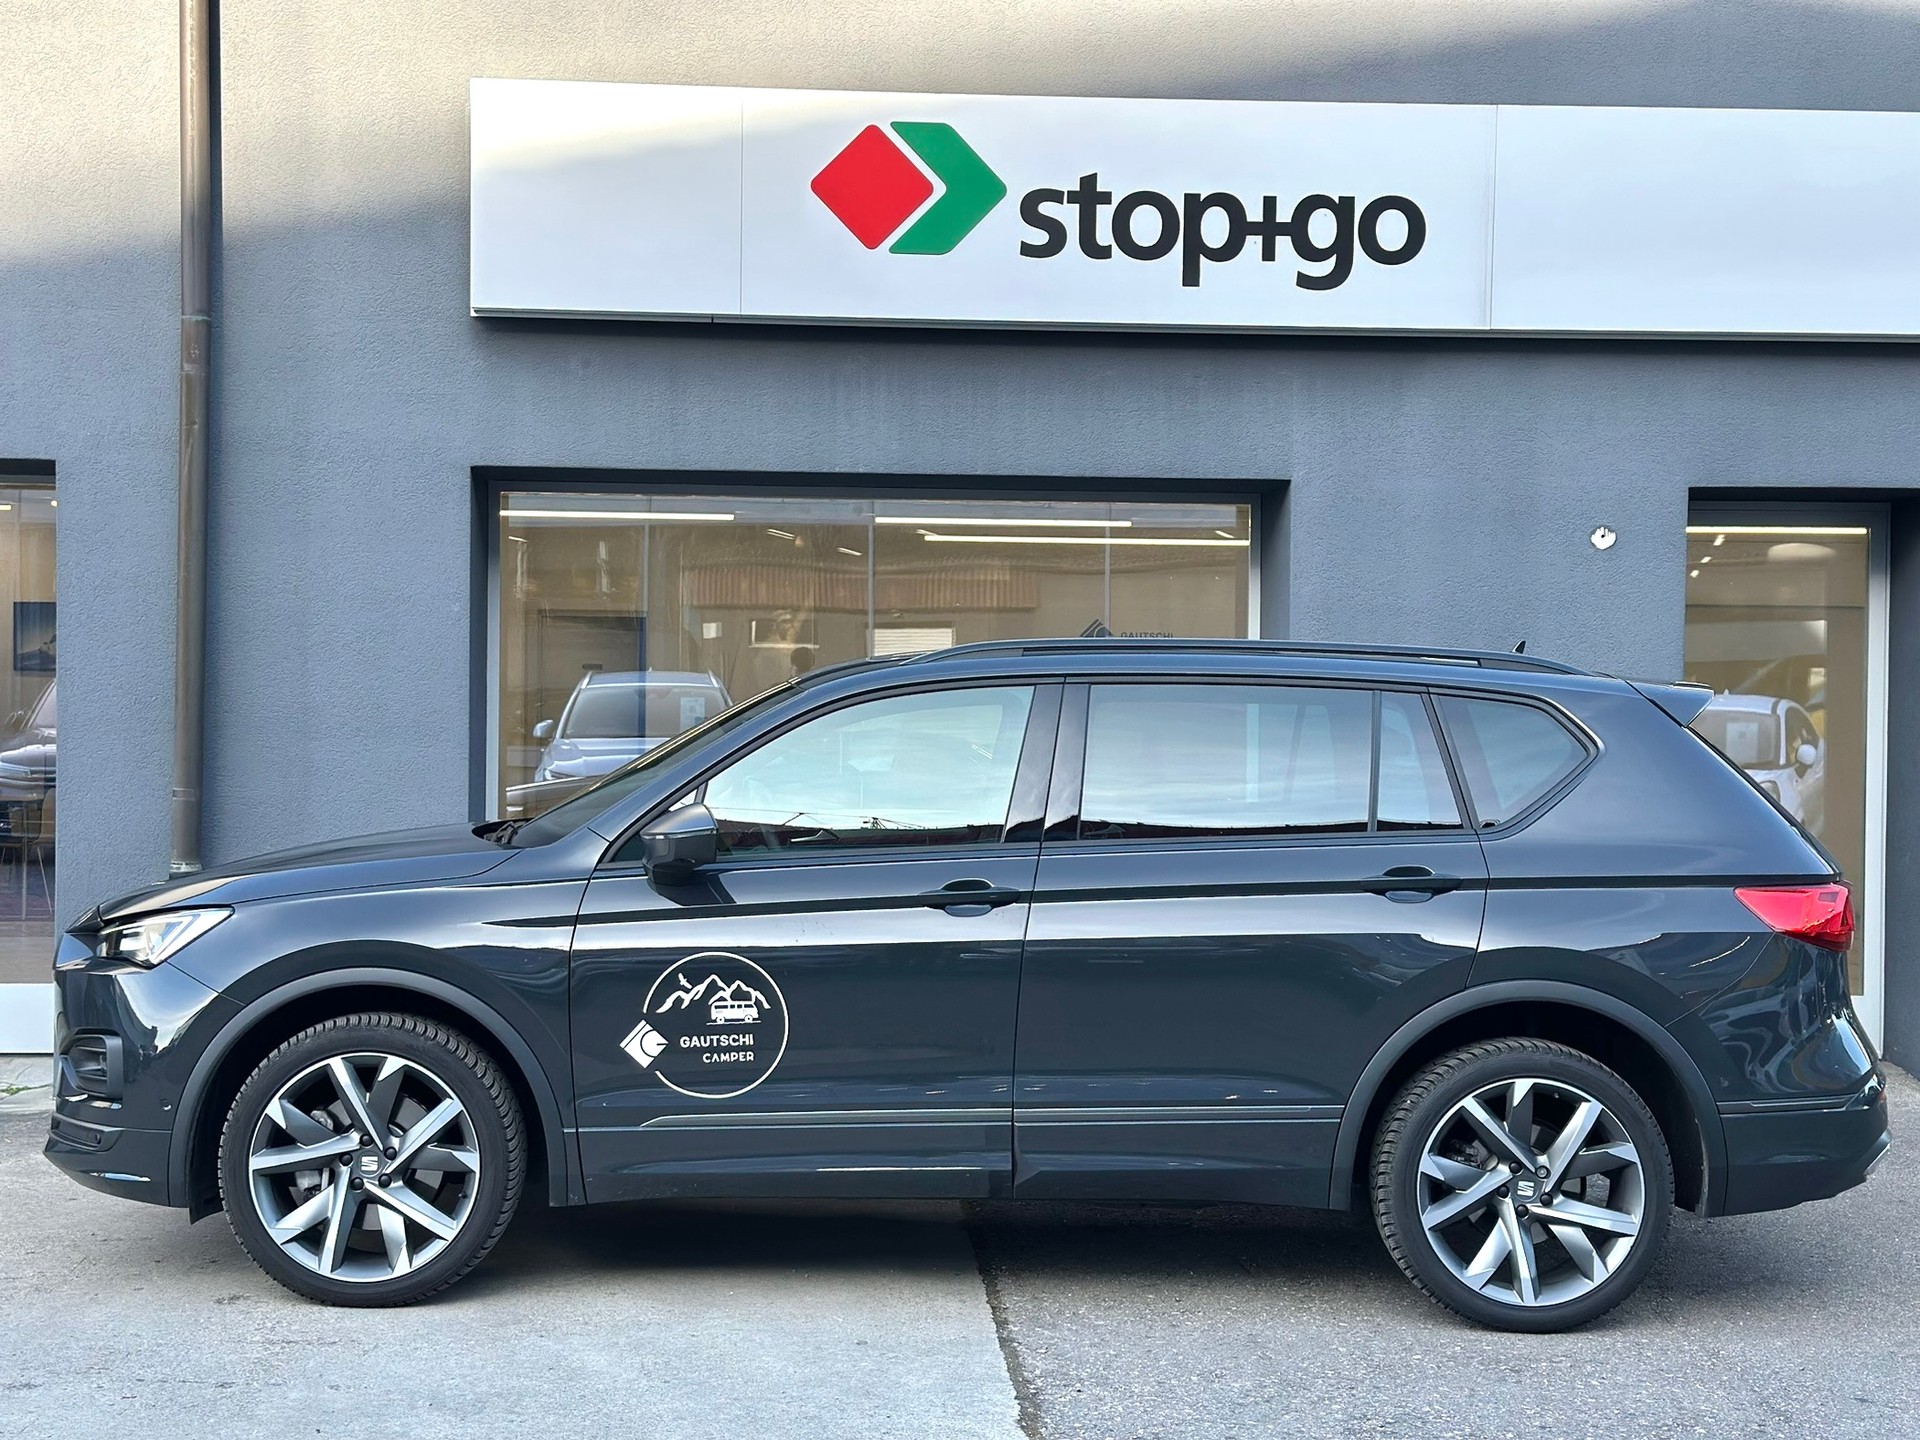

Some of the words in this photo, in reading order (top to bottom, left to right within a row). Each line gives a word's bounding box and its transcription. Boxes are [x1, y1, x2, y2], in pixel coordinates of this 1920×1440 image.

[1020, 173, 1426, 290] stop+go
[679, 1033, 755, 1048] GAUTSCHI
[702, 1051, 755, 1063] CAMPER
